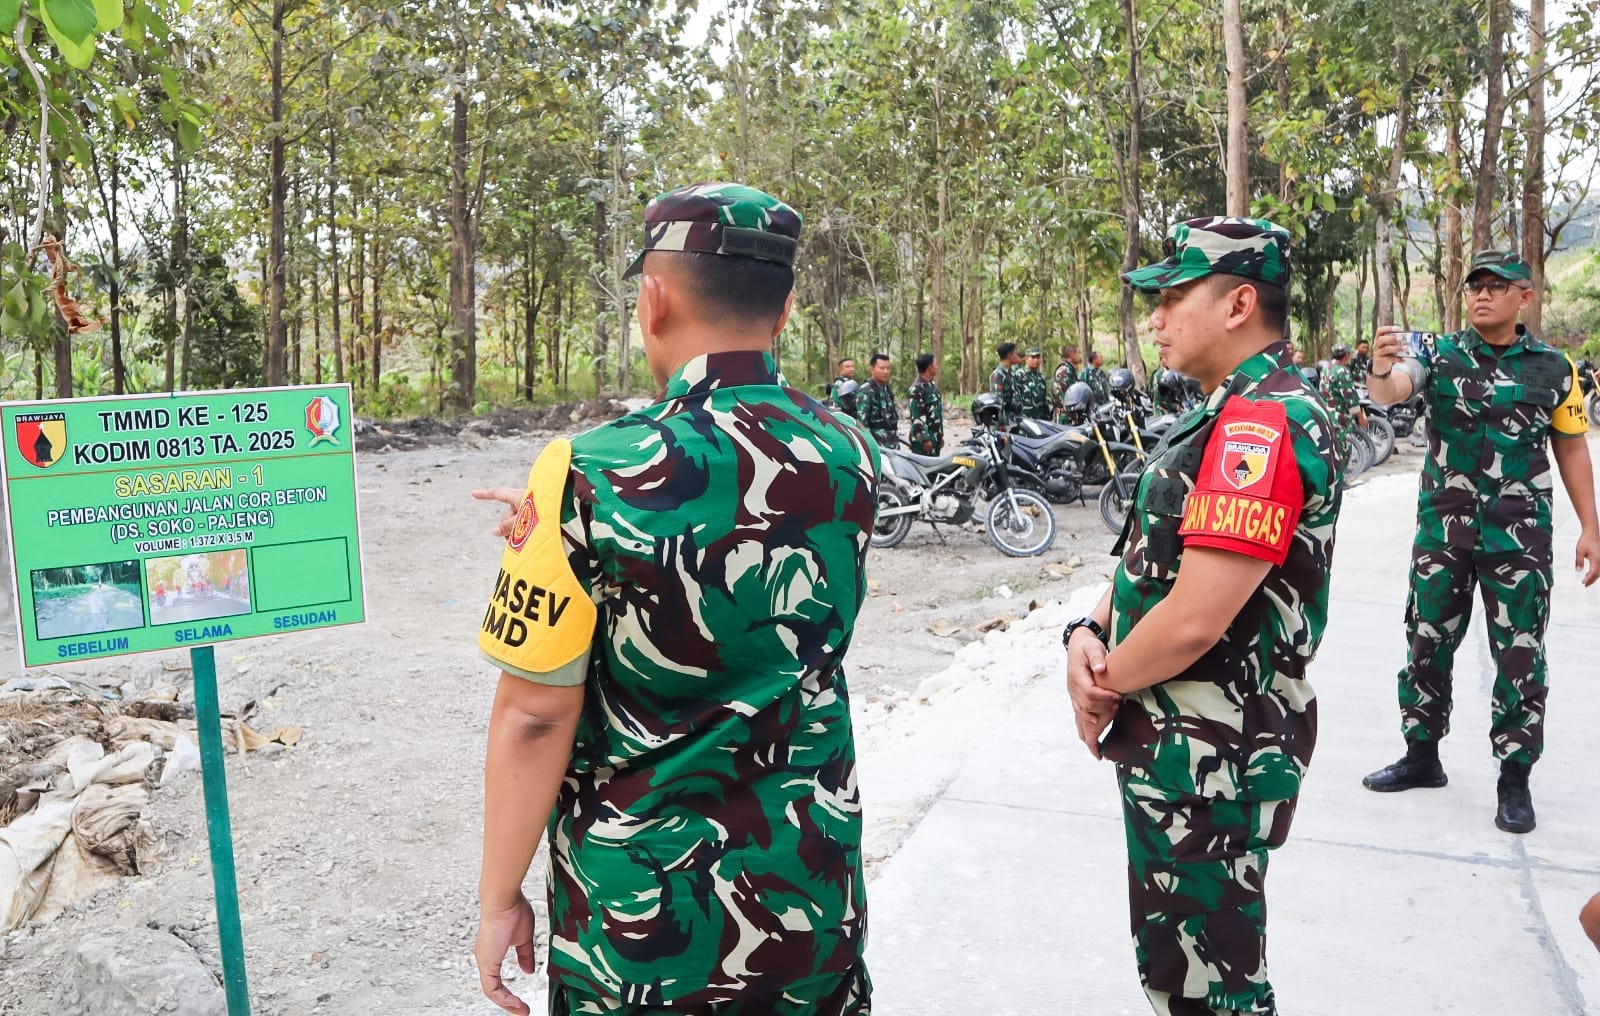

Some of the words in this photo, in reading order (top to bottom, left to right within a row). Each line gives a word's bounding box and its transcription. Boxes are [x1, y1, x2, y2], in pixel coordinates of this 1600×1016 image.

[16, 413, 64, 422] BRAWIJAYA
[98, 410, 170, 433] TMMD
[177, 406, 210, 427] KE
[231, 402, 268, 424] 125
[1567, 404, 1583, 417] TIM
[1228, 424, 1255, 433] KODIM
[73, 441, 151, 465] KODIM
[156, 436, 205, 459] 0813
[210, 433, 243, 455] TA.
[248, 430, 295, 451] 2025
[1227, 443, 1268, 454] BRAWIJAYA
[114, 468, 232, 498] SASARAN
[252, 465, 264, 486] 1
[47, 501, 178, 527] PEMBANGUNAN
[182, 495, 234, 514] JALAN
[238, 491, 271, 508] COR
[275, 486, 327, 505] BETON
[110, 523, 143, 543] (DS.
[148, 517, 194, 537] SOKO
[208, 510, 274, 533] PAJENG)
[1211, 495, 1285, 546] SATGAS
[135, 538, 180, 553] VOLUME
[190, 535, 216, 548] 1.372
[217, 534, 225, 545] X
[227, 533, 243, 545] 3,5
[244, 531, 253, 542] M
[274, 610, 337, 629] SESUDAH
[174, 624, 232, 643] SELAMA
[57, 637, 129, 658] SEBELUM
